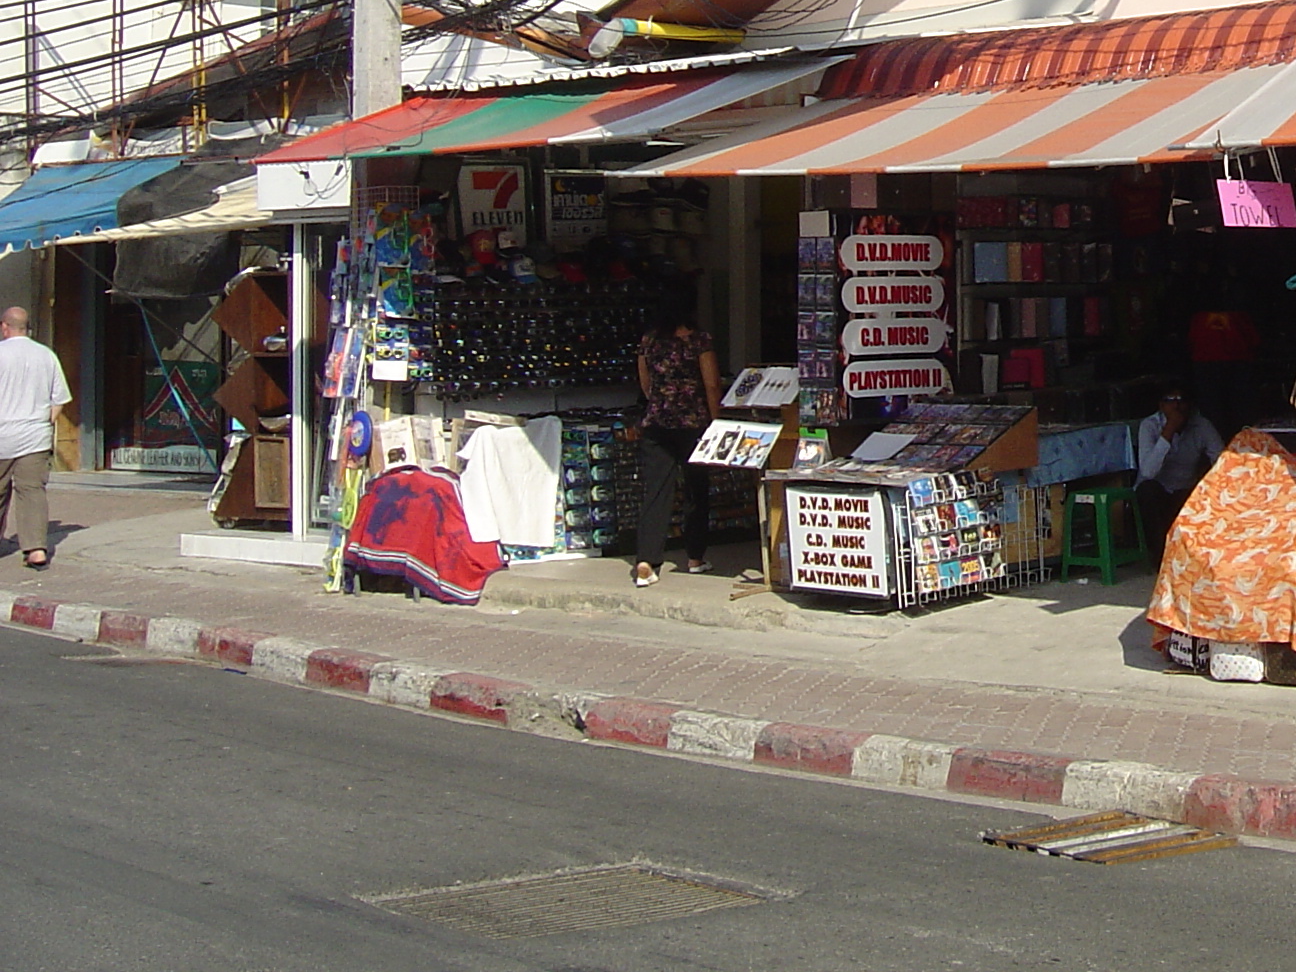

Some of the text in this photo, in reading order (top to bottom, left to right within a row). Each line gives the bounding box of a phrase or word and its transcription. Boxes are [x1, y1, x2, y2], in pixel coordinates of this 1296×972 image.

[1230, 203, 1283, 227] TOWEL
[860, 326, 929, 346] C.D. MUSIC
[849, 369, 931, 391] PLAYSTATION
[799, 496, 870, 513] D.V.D. MOVIE
[799, 513, 871, 531] D.V.D. MUSIC
[806, 533, 866, 550] C.D. MUSIC
[802, 551, 873, 570] X-BOX GAME
[797, 569, 868, 589] PLAYSTATION
